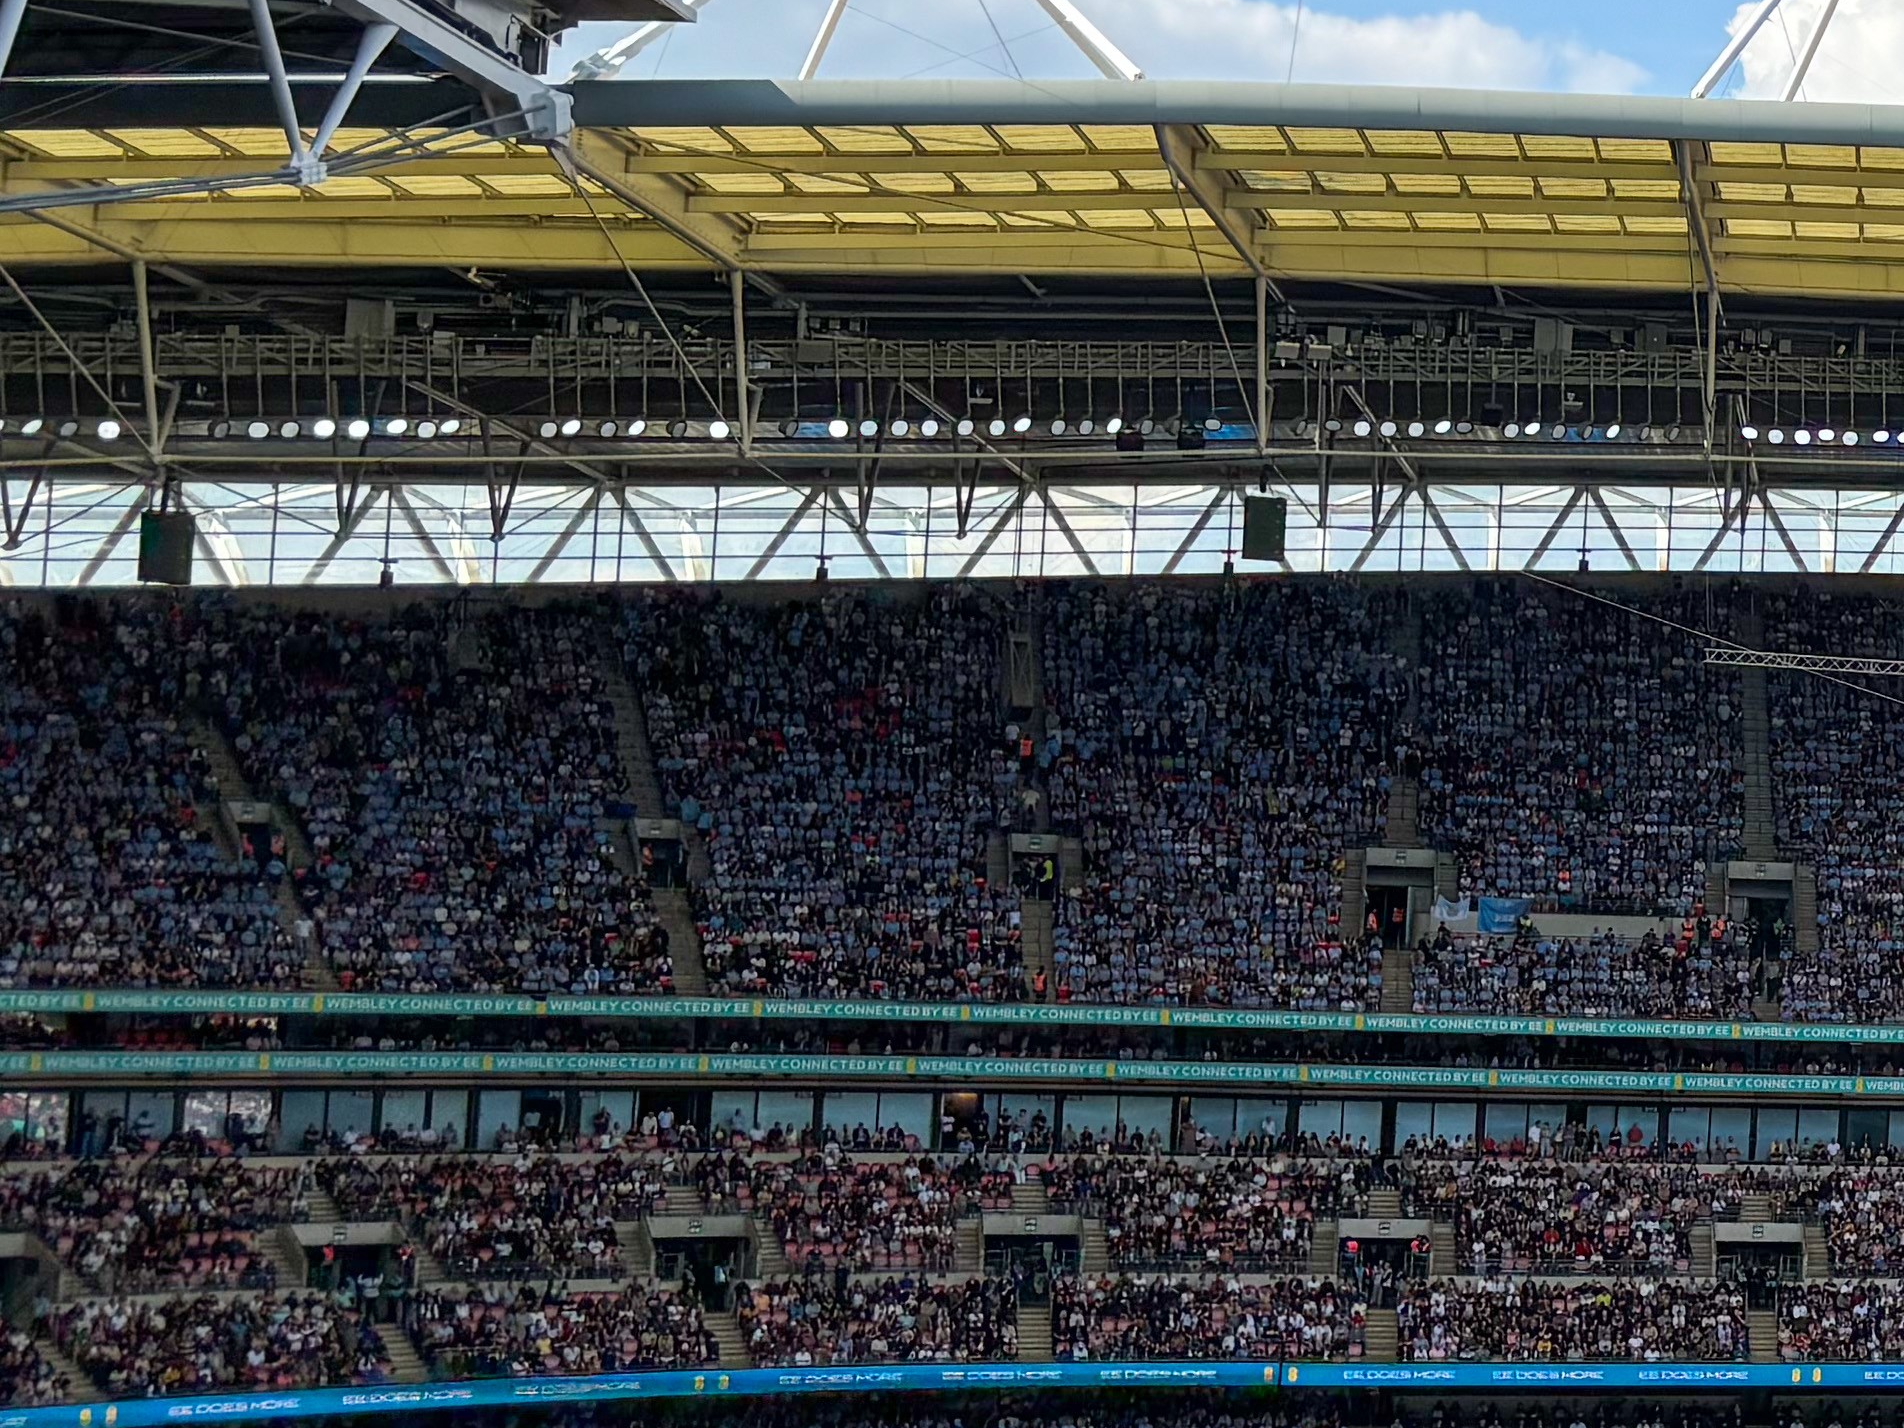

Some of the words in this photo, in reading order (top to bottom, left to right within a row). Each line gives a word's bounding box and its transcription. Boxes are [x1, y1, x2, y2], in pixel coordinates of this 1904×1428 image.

[766, 1003, 832, 1014] WEMBLEY
[834, 1005, 920, 1016] CONNECTED
[1367, 1017, 1427, 1028] WEMBLEY
[1430, 1019, 1507, 1029] CONNECTED
[1557, 1022, 1616, 1032] WEMBLEY
[1618, 1023, 1694, 1034] CONNECTED
[1743, 1026, 1800, 1036] WEMBLEY
[1802, 1027, 1877, 1038] CONNECTED
[496, 1057, 564, 1067] WEMBLEY
[568, 1057, 656, 1068] CONNECTED
[1311, 1069, 1372, 1079] WEMBLEY
[1374, 1070, 1450, 1081] CONNECTED
[1500, 1073, 1558, 1083] WEMBLEY
[1561, 1074, 1637, 1085] CONNECTED
[195, 1402, 248, 1414] DOES
